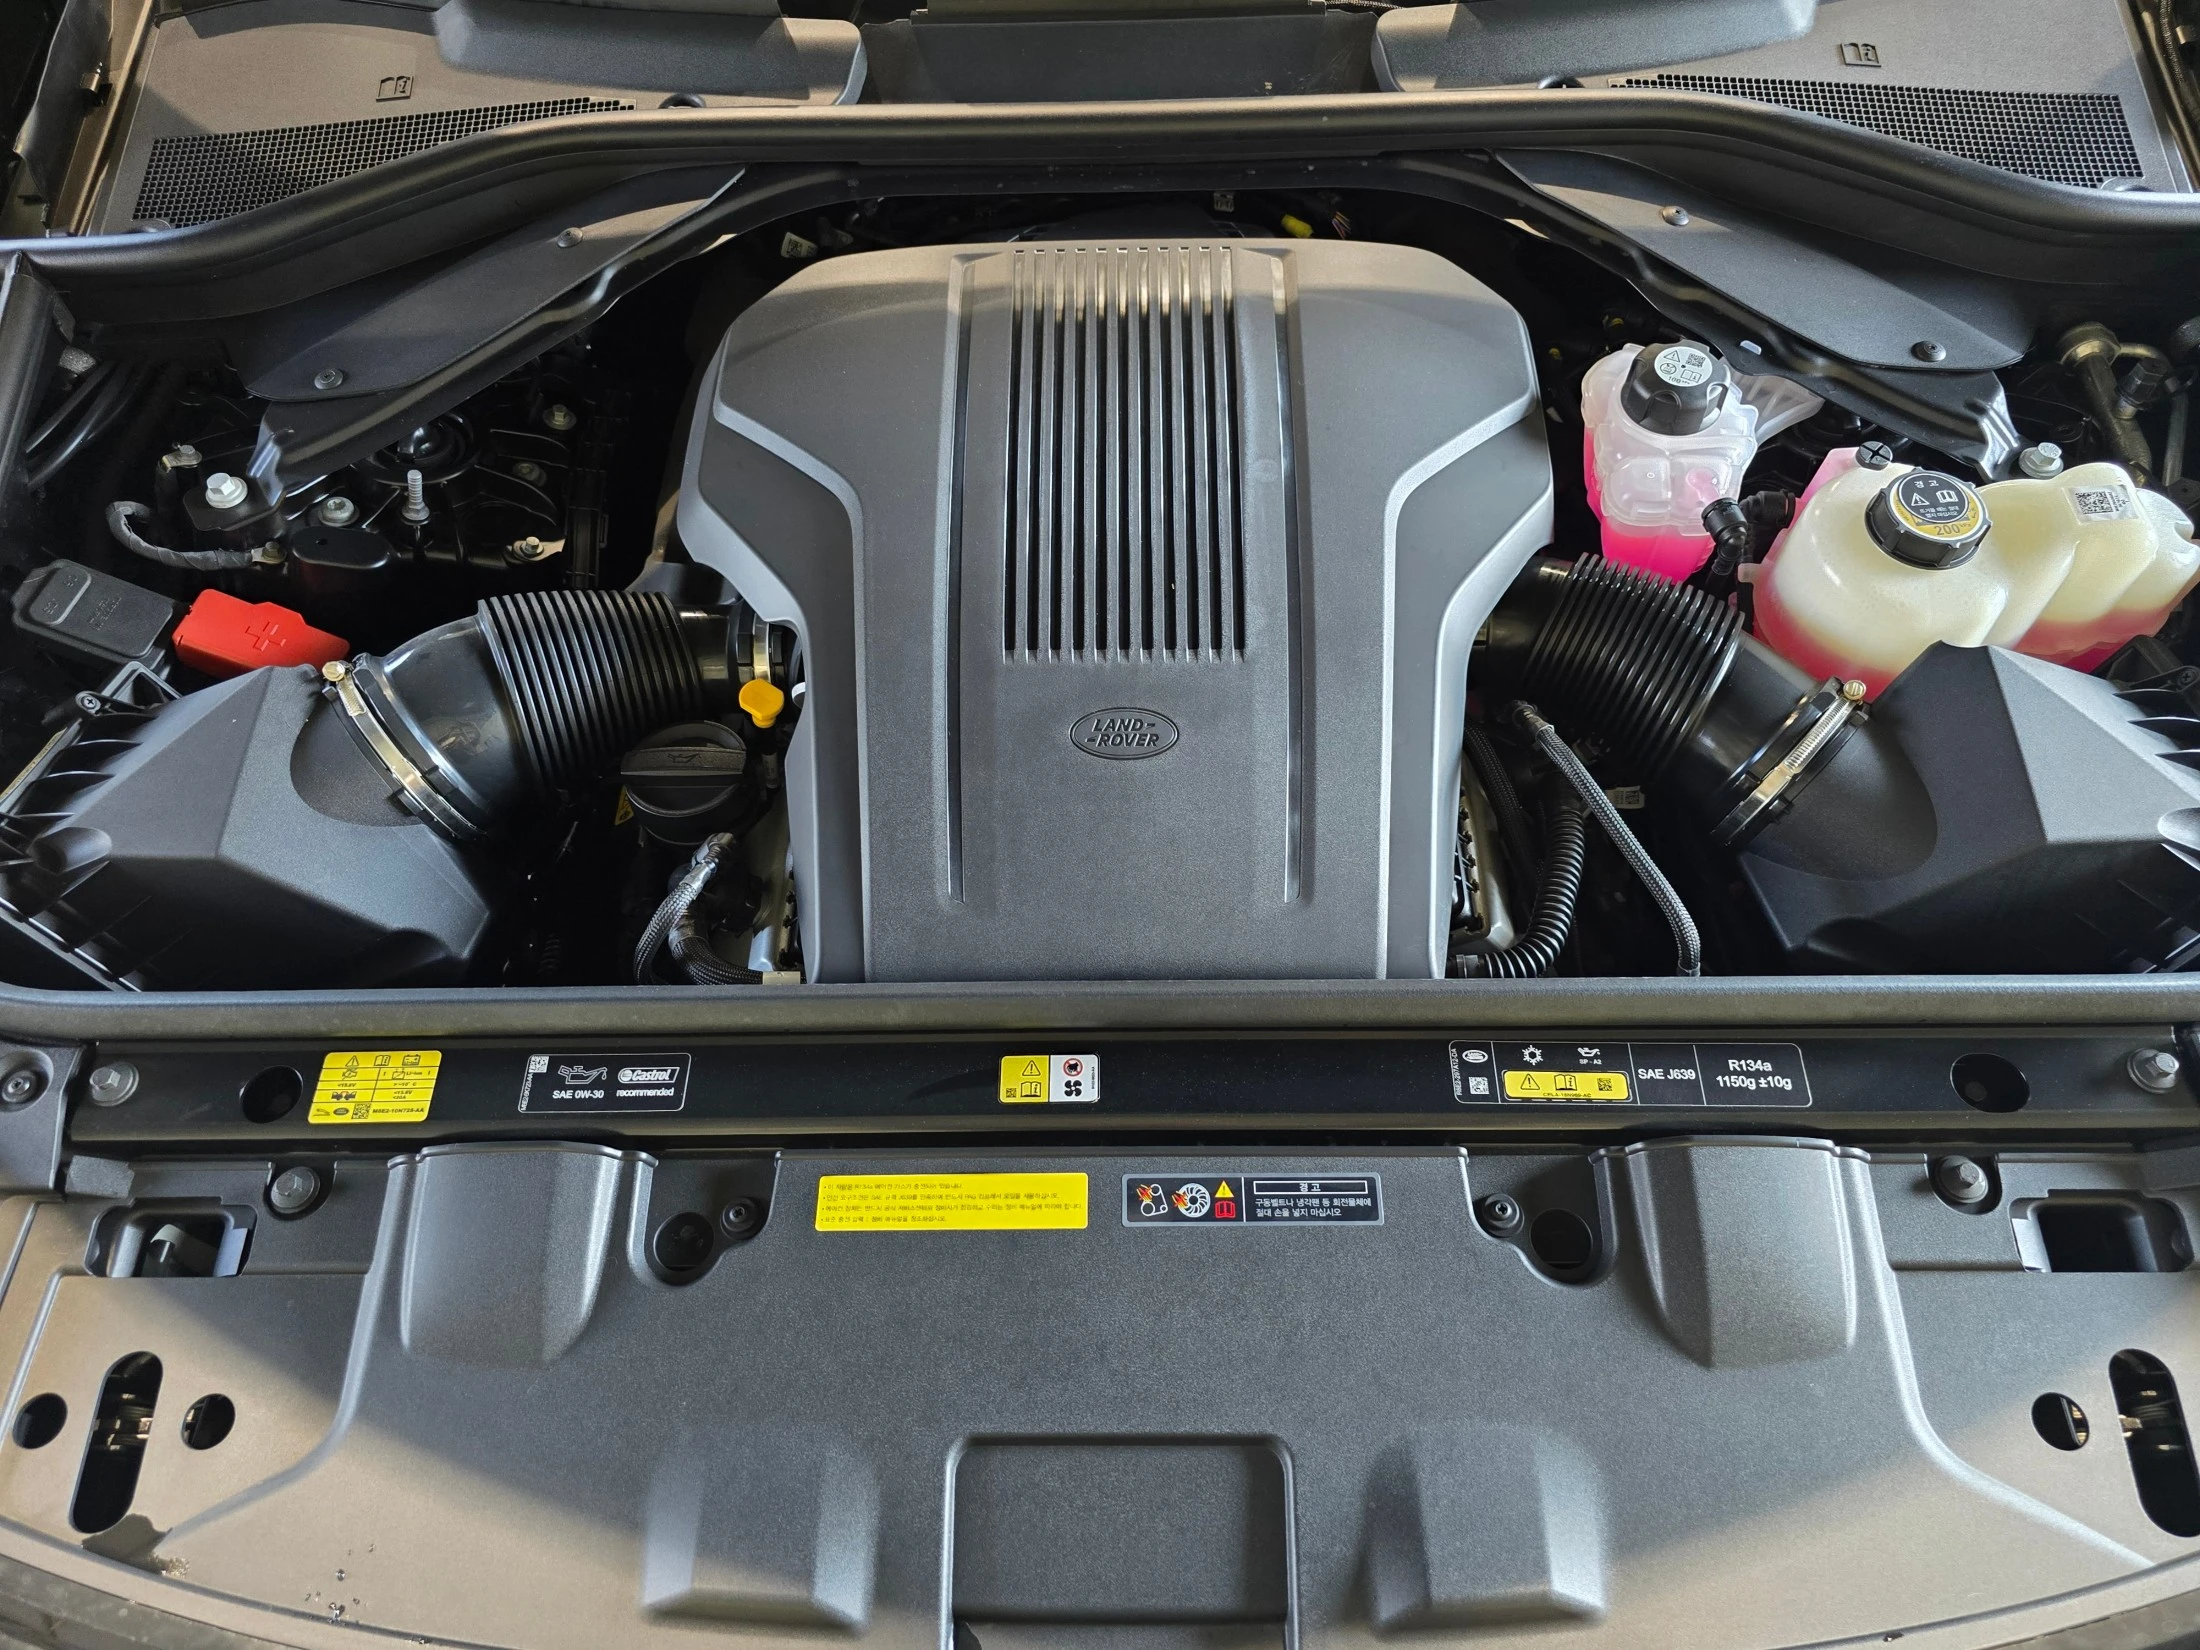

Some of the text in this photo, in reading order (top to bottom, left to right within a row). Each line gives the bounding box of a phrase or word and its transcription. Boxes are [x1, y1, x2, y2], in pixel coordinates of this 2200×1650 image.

[1728, 1059, 1772, 1072] R134a
[632, 1069, 670, 1081] Castrol
[1638, 1069, 1696, 1080] SAE J639
[1716, 1076, 1792, 1091] 1150g ±10g
[552, 1090, 604, 1099] SAE 0W-30
[616, 1088, 674, 1097] recommended
[1300, 1183, 1320, 1192] 경 고
[1322, 1198, 1330, 1206] 등
[1256, 1208, 1341, 1217] 절대 손을 넣지 마십시오
